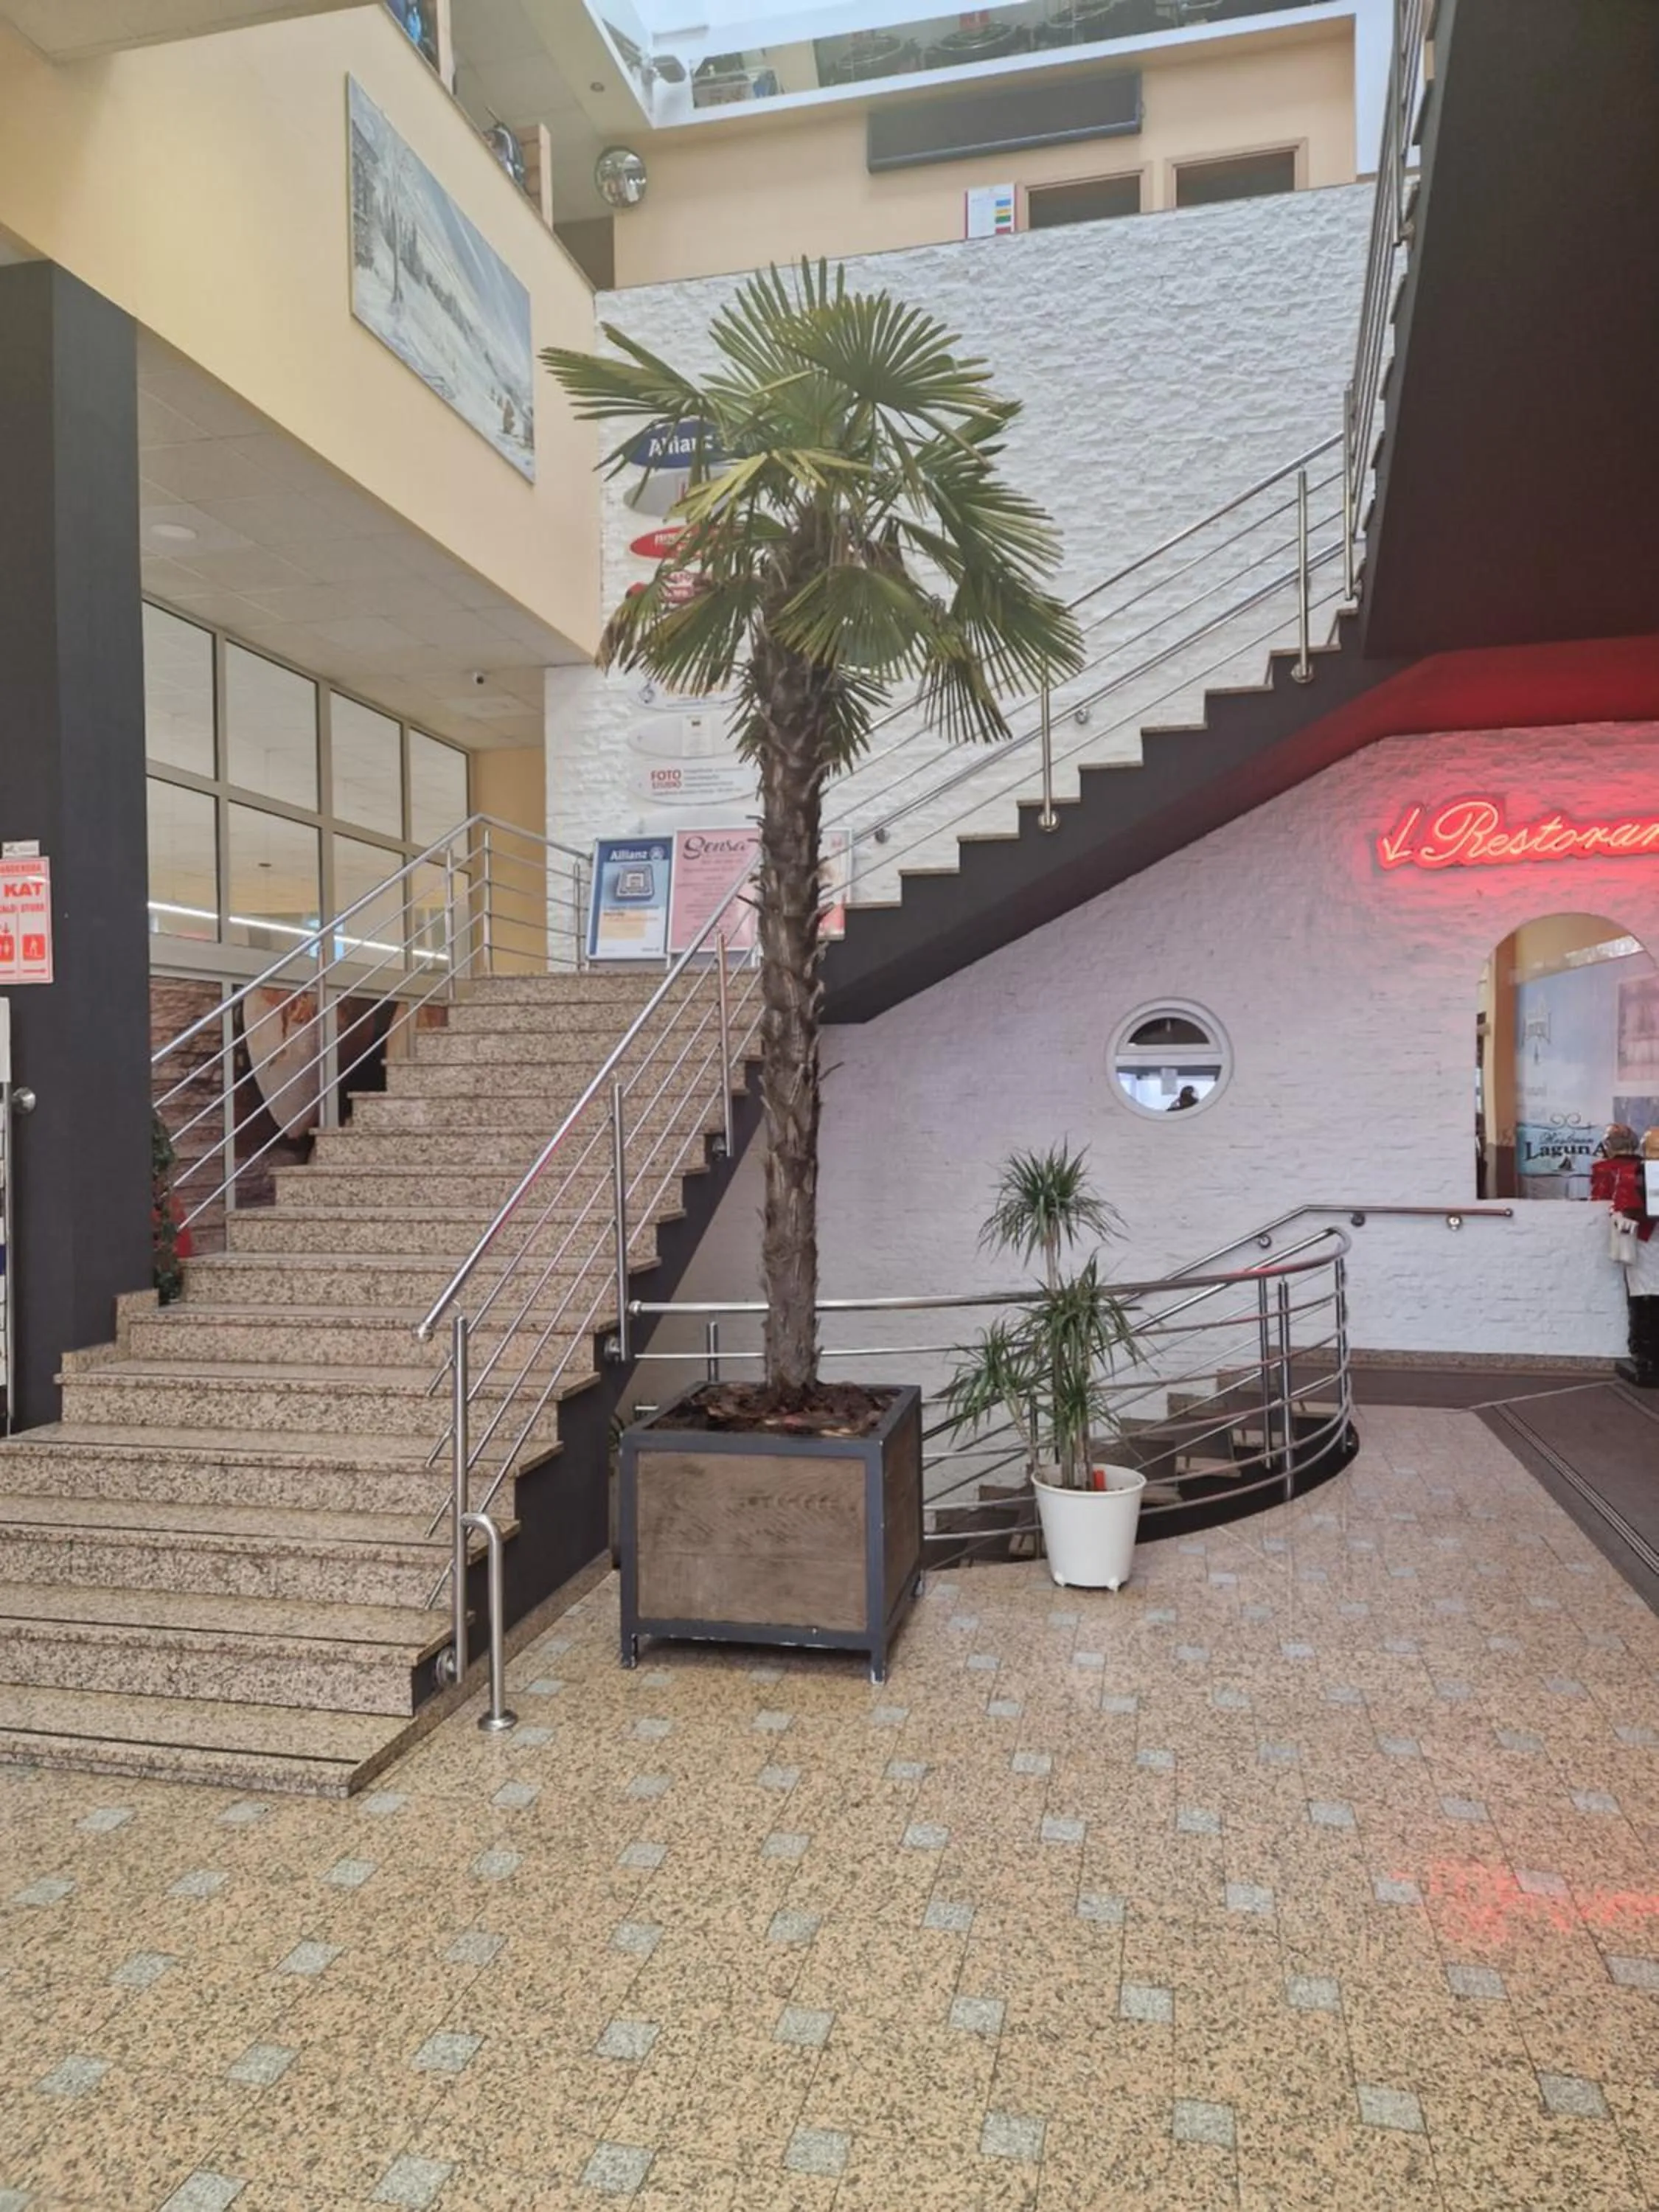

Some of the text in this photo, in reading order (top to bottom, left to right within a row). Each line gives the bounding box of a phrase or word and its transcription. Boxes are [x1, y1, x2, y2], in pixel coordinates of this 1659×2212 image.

[650, 769, 681, 782] FOTO
[610, 849, 647, 861] Allianz
[4, 883, 44, 897] KAT
